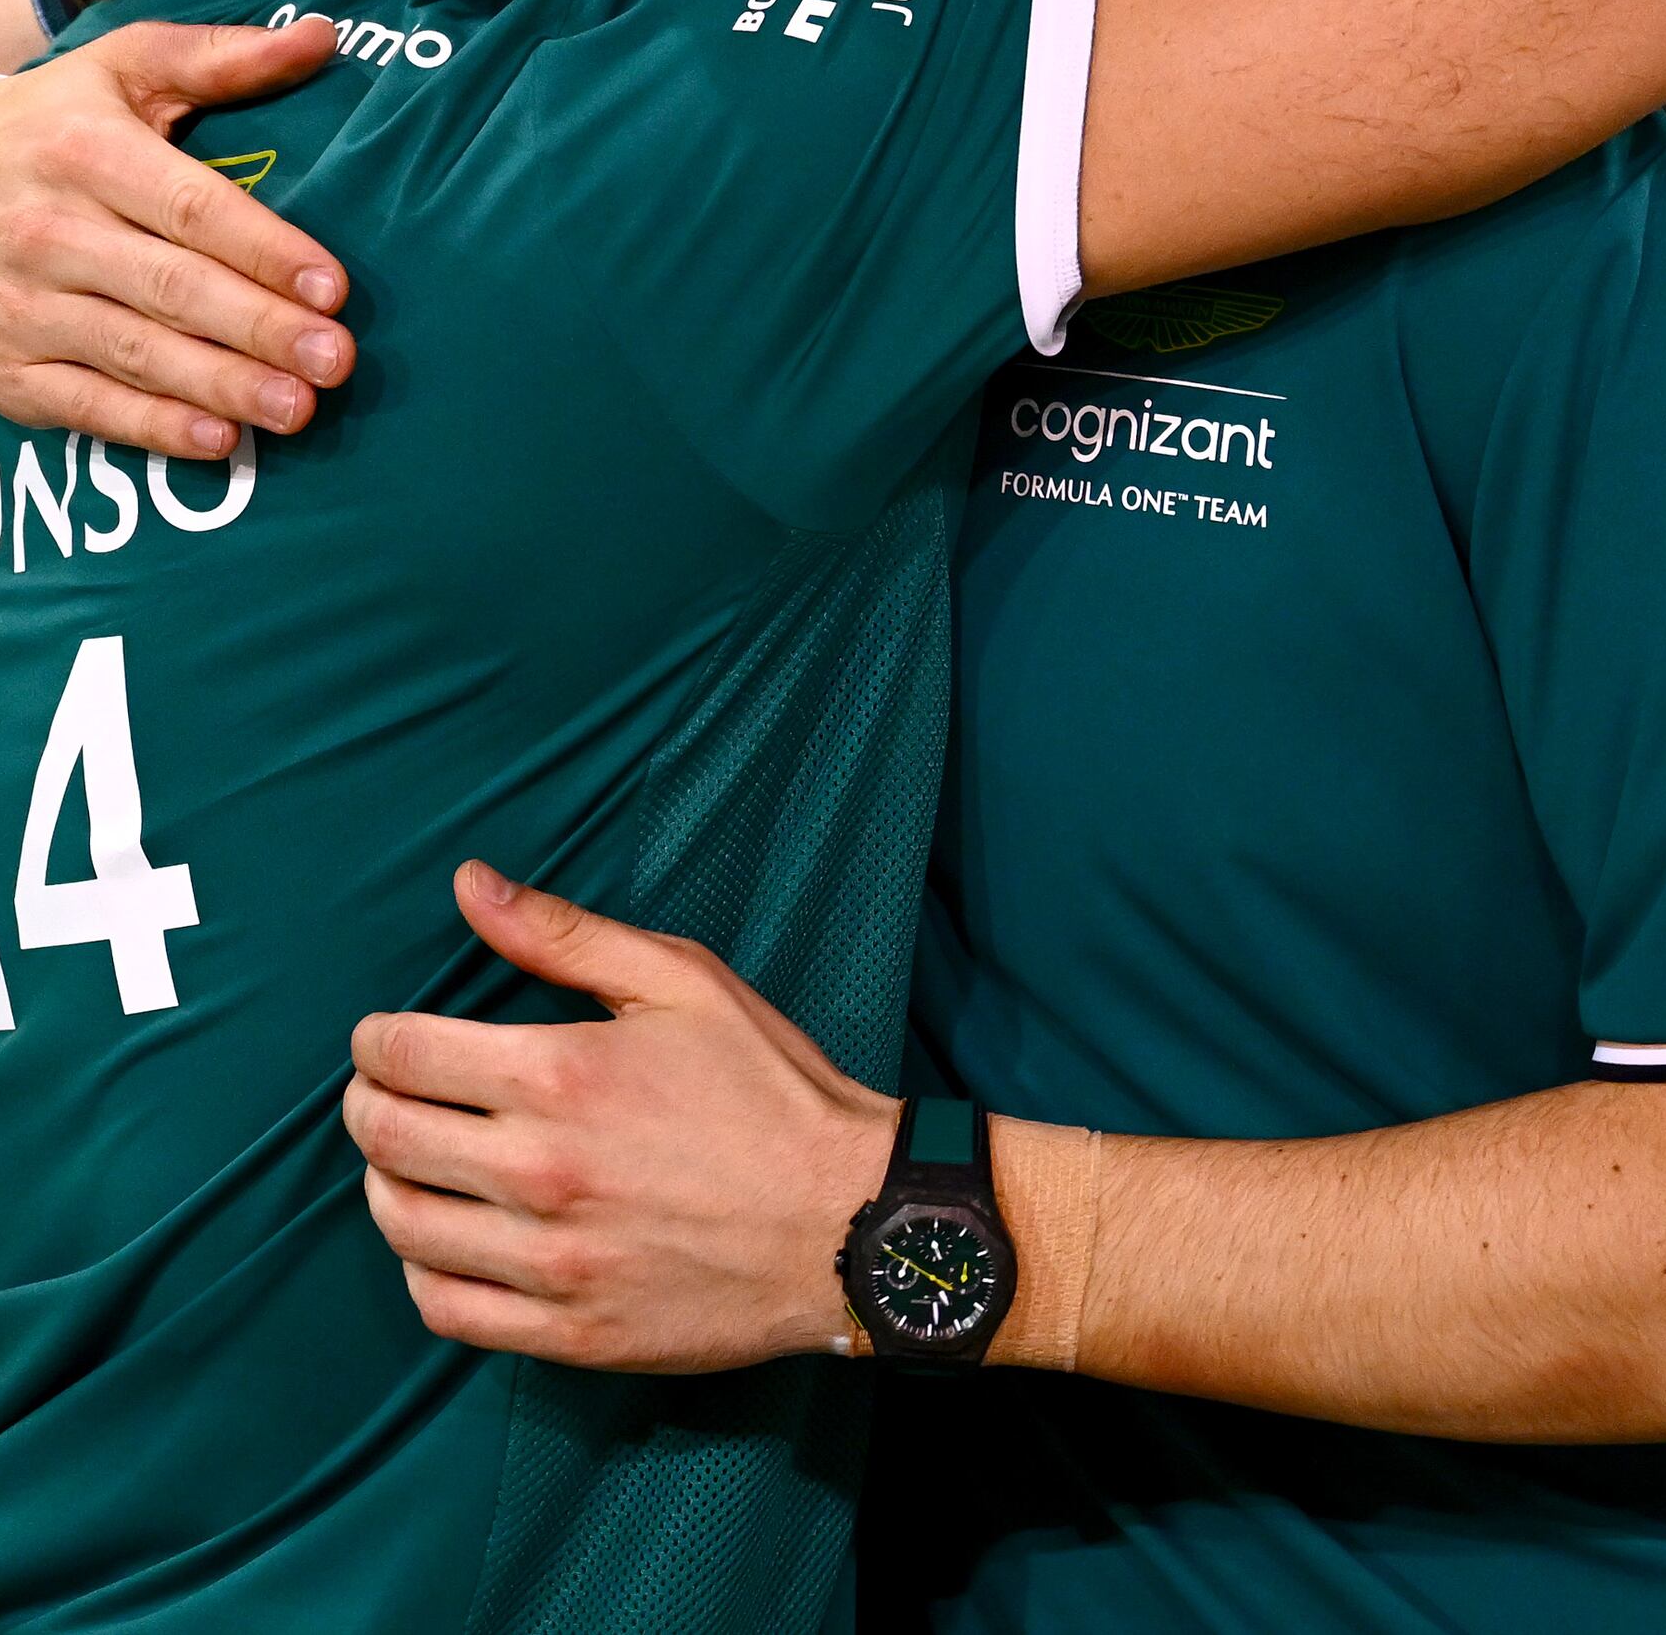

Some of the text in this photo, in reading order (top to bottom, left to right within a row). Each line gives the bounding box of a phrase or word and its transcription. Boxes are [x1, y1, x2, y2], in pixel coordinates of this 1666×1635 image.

[1010, 398, 1276, 470] cognizant
[1000, 471, 1114, 508] FORMULA
[1194, 494, 1267, 528] TEAM
